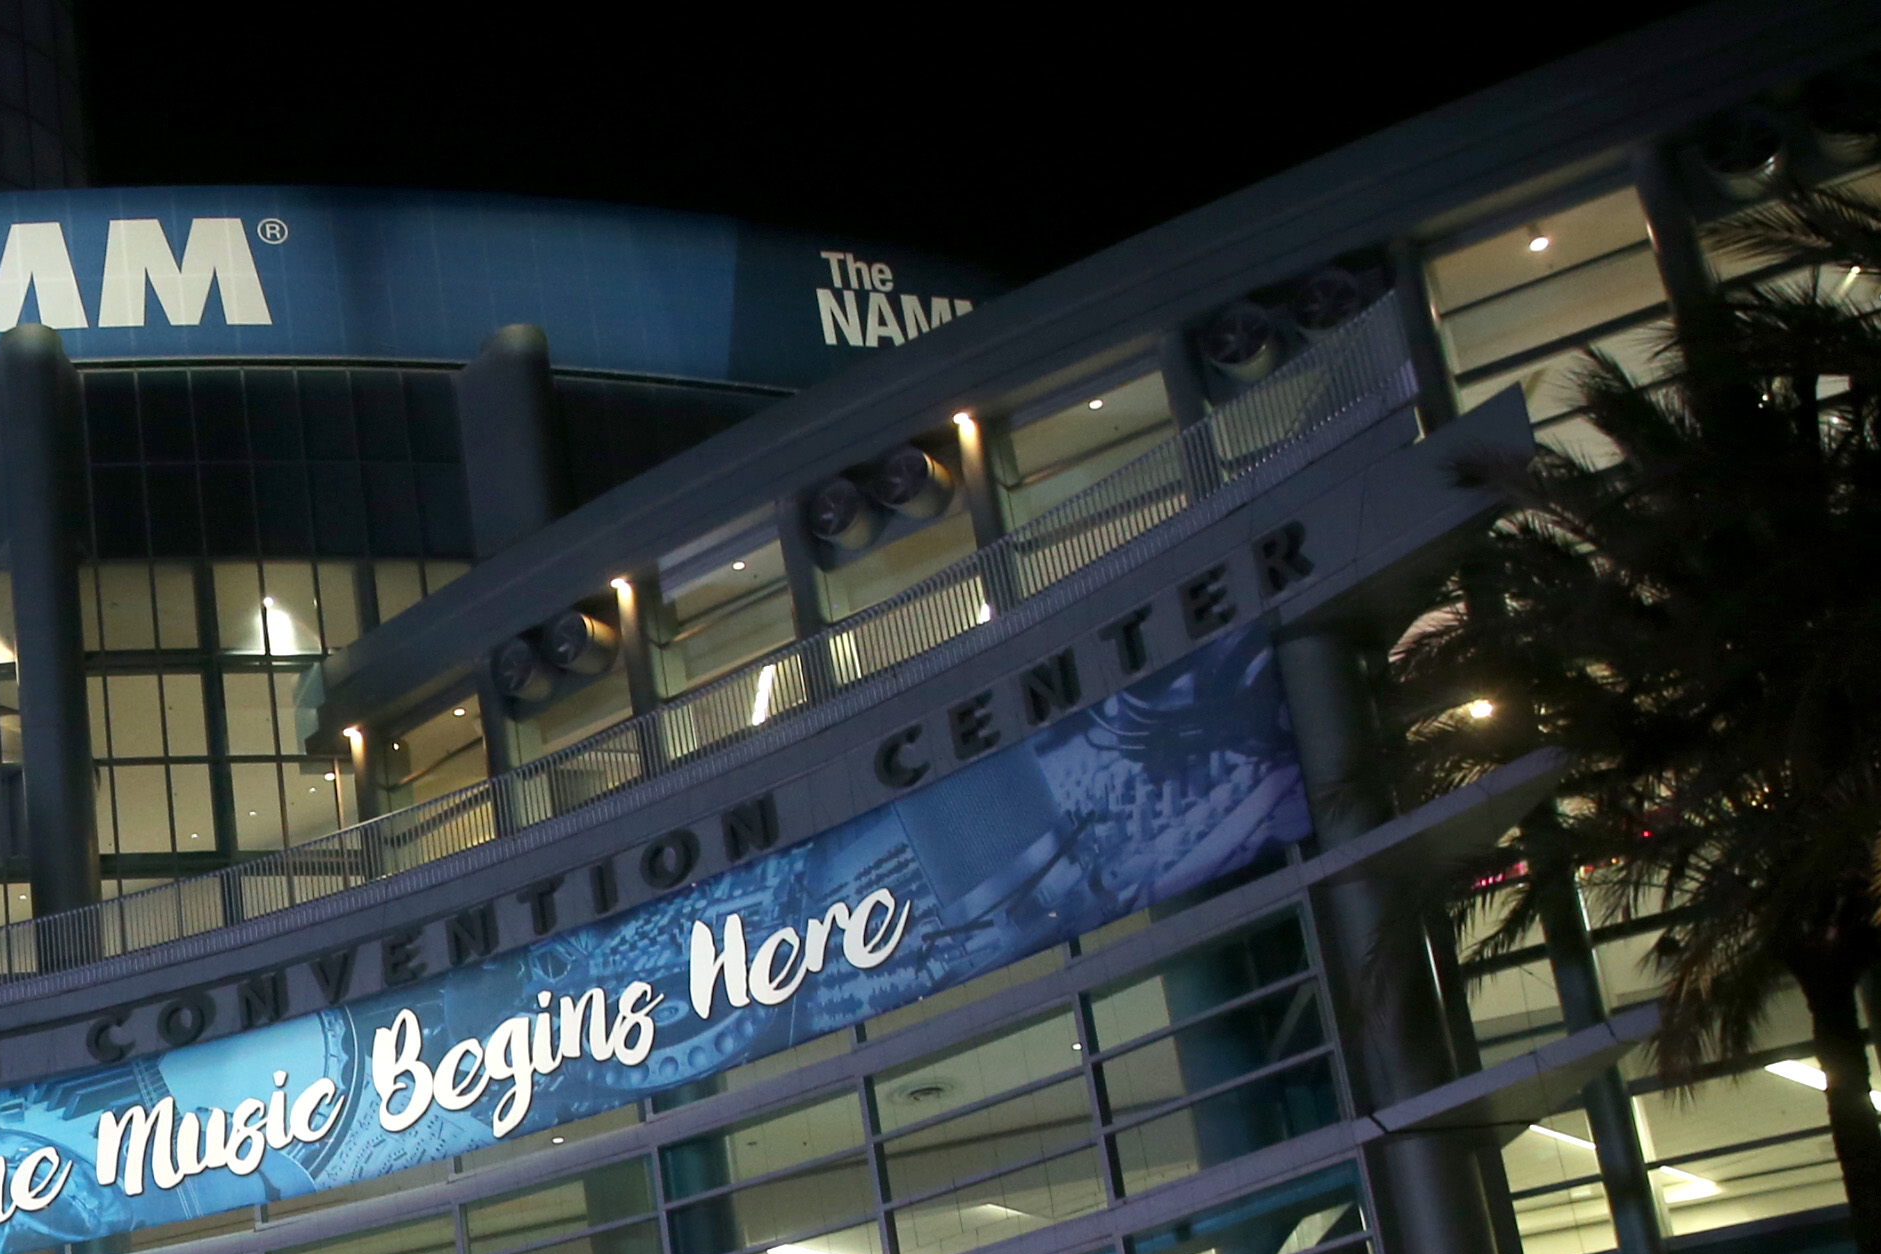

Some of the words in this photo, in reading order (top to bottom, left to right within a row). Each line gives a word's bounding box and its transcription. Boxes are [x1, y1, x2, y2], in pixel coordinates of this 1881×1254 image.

[820, 251, 894, 293] The
[87, 795, 780, 1064] CONVENTION
[875, 518, 1319, 790] CENTER
[95, 1069, 347, 1198] Music
[371, 978, 663, 1138] Begins
[687, 886, 910, 1020] Here
